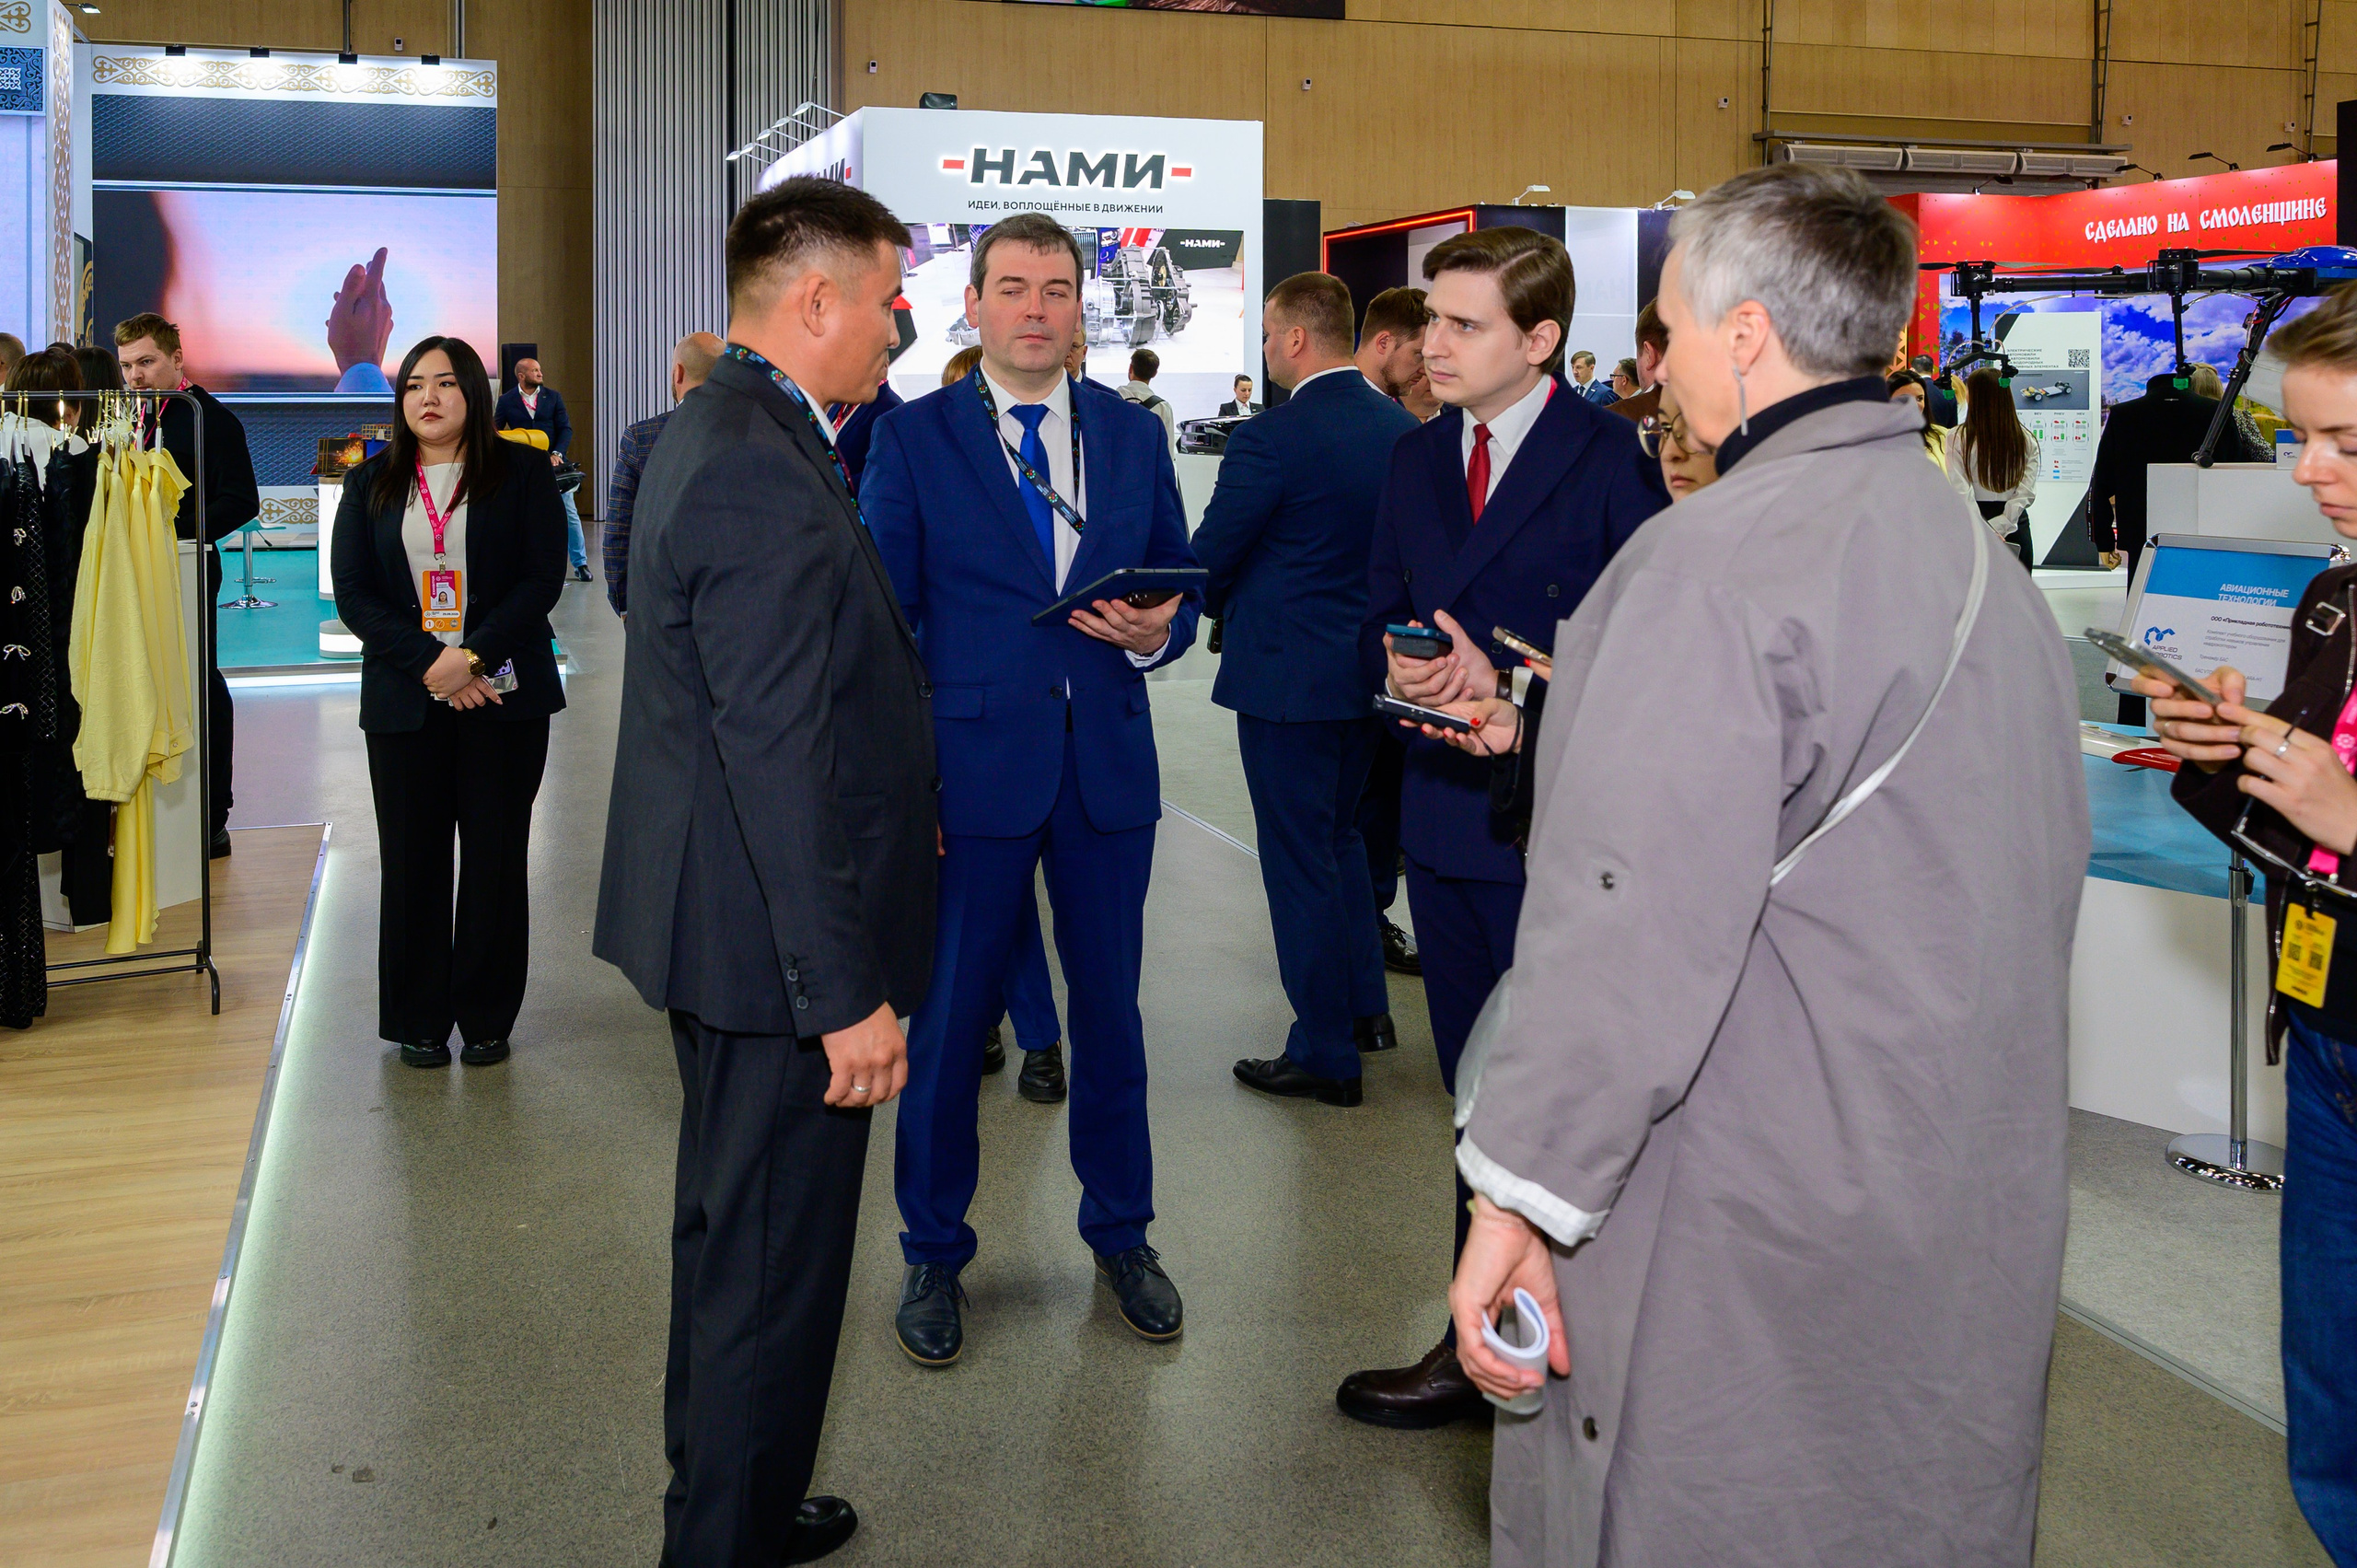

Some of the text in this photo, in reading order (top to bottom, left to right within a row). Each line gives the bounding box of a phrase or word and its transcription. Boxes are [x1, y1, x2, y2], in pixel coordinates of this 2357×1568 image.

[970, 147, 1166, 190] НАМИ
[968, 200, 1164, 214] ИДЕИ, ВОПЛОЩЁННЫЕ В ДВИЖЕНИИ
[2084, 196, 2328, 243] СДЕЛАНО НА СМОЛЕНЩИНЕ
[2219, 583, 2290, 598] АВИАЦИОННЫЕ
[2217, 593, 2278, 607] ТЕХНОЛОГИИ
[2152, 645, 2178, 653] APPLIED
